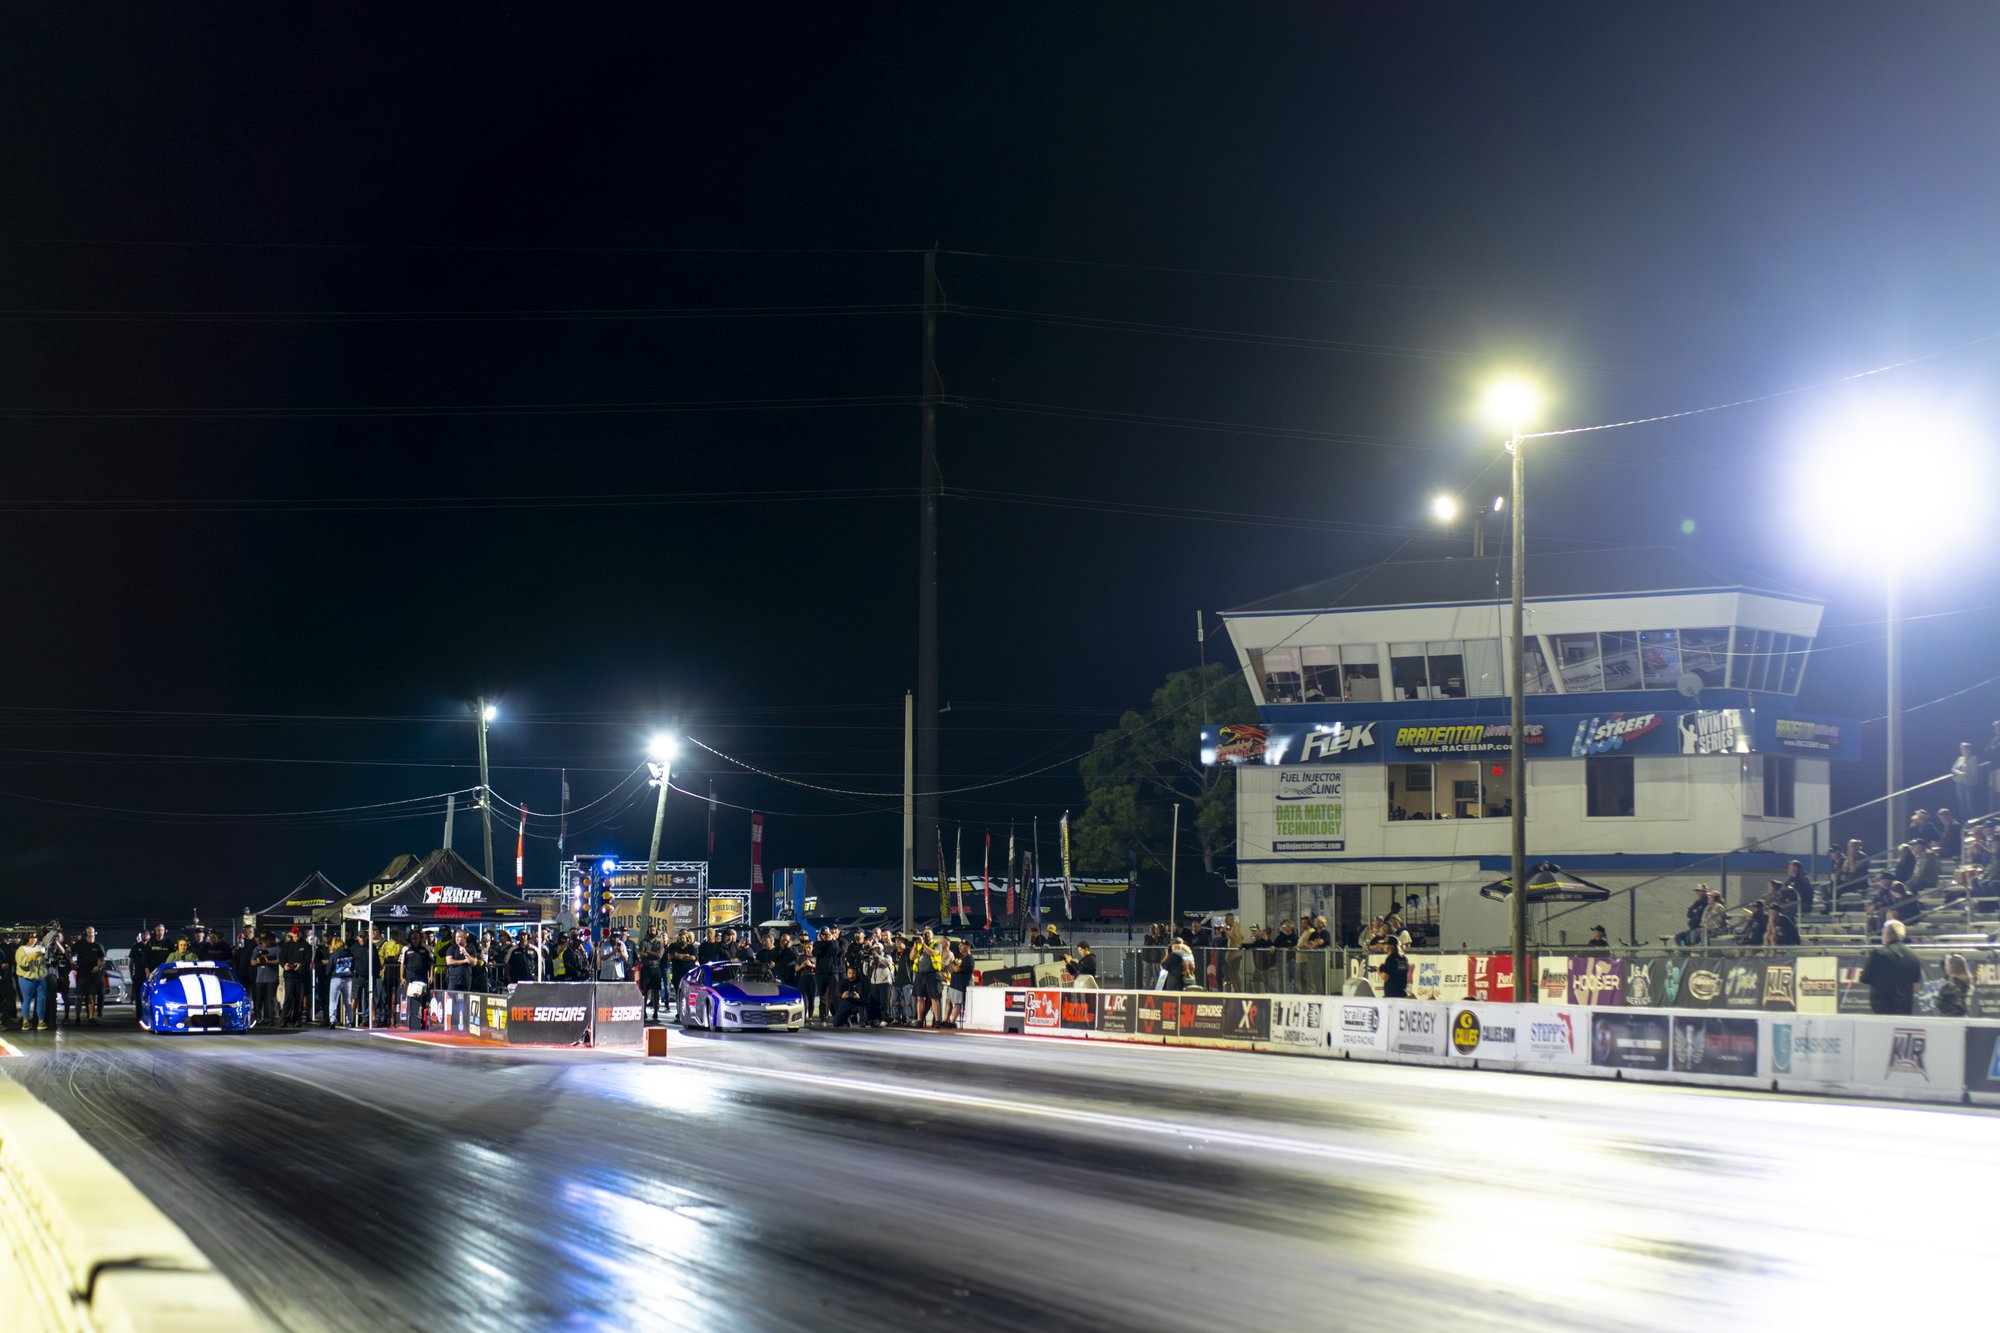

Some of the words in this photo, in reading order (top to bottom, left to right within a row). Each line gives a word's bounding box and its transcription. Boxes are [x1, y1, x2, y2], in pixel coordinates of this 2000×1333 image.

[1594, 714, 1655, 740] STREET
[1395, 725, 1484, 746] BRADENTON
[1698, 729, 1735, 751] SERIES
[1413, 743, 1513, 753] www.RACEBMP.co
[1281, 772, 1300, 782] FUEL
[1303, 772, 1341, 782] INJECTOR
[1311, 783, 1341, 794] CLINIC
[1276, 804, 1302, 821] DATA
[1305, 804, 1342, 820] MATCH
[1276, 821, 1341, 835] TECHNOLOGY
[1276, 843, 1341, 851] fuelinjectorclinic.com
[443, 889, 481, 898] WINTER
[611, 914, 634, 929] ORLD
[1445, 974, 1467, 983] ELITE
[1573, 975, 1620, 990] HOOSIER
[1197, 1005, 1223, 1017] REDHORSE
[1399, 1008, 1437, 1034] ENERGY
[1455, 1027, 1479, 1046] CALLIES
[1482, 1026, 1516, 1043] CALLIES.COM
[1531, 1022, 1566, 1043] STEPP'S
